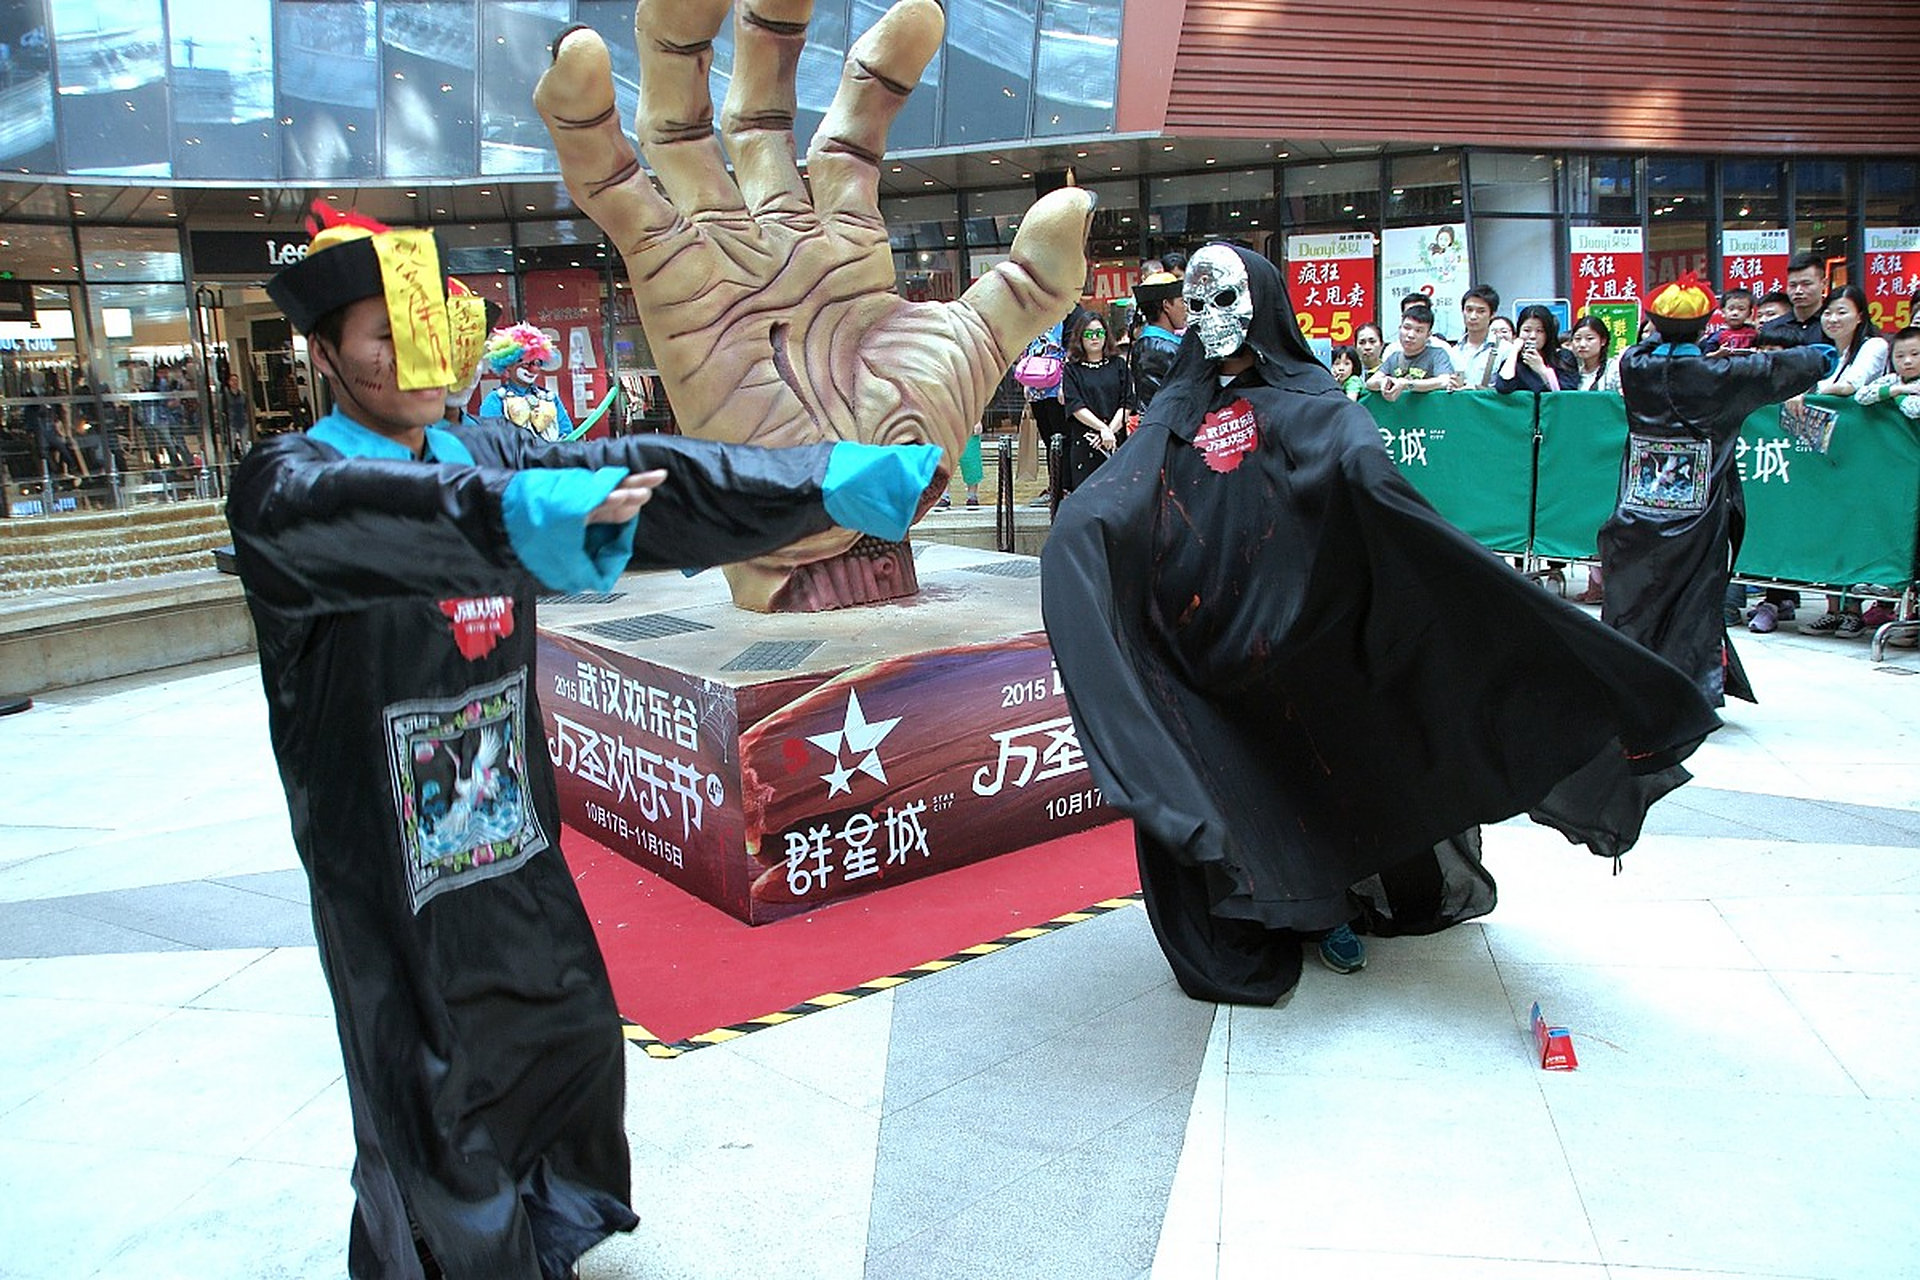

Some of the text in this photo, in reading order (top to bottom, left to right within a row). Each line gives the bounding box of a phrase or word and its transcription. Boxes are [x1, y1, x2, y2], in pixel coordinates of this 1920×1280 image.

[266, 240, 309, 265] Lee
[1870, 254, 1904, 275] 疯狂
[1298, 262, 1341, 285] 疯狂
[1579, 254, 1616, 278] 疯狂
[1728, 257, 1764, 279] 疯狂
[1304, 282, 1366, 308] 大甩卖
[1585, 276, 1637, 301] 大甩卖
[1868, 301, 1911, 329] 2-5
[554, 660, 700, 752] 2015 武汉欢乐谷
[1000, 678, 1047, 709] 2015
[547, 711, 705, 843] 万圣欢乐节
[933, 800, 954, 812] CITY
[584, 799, 685, 870] 10月17日-11月15日
[784, 799, 931, 896] 群星城
